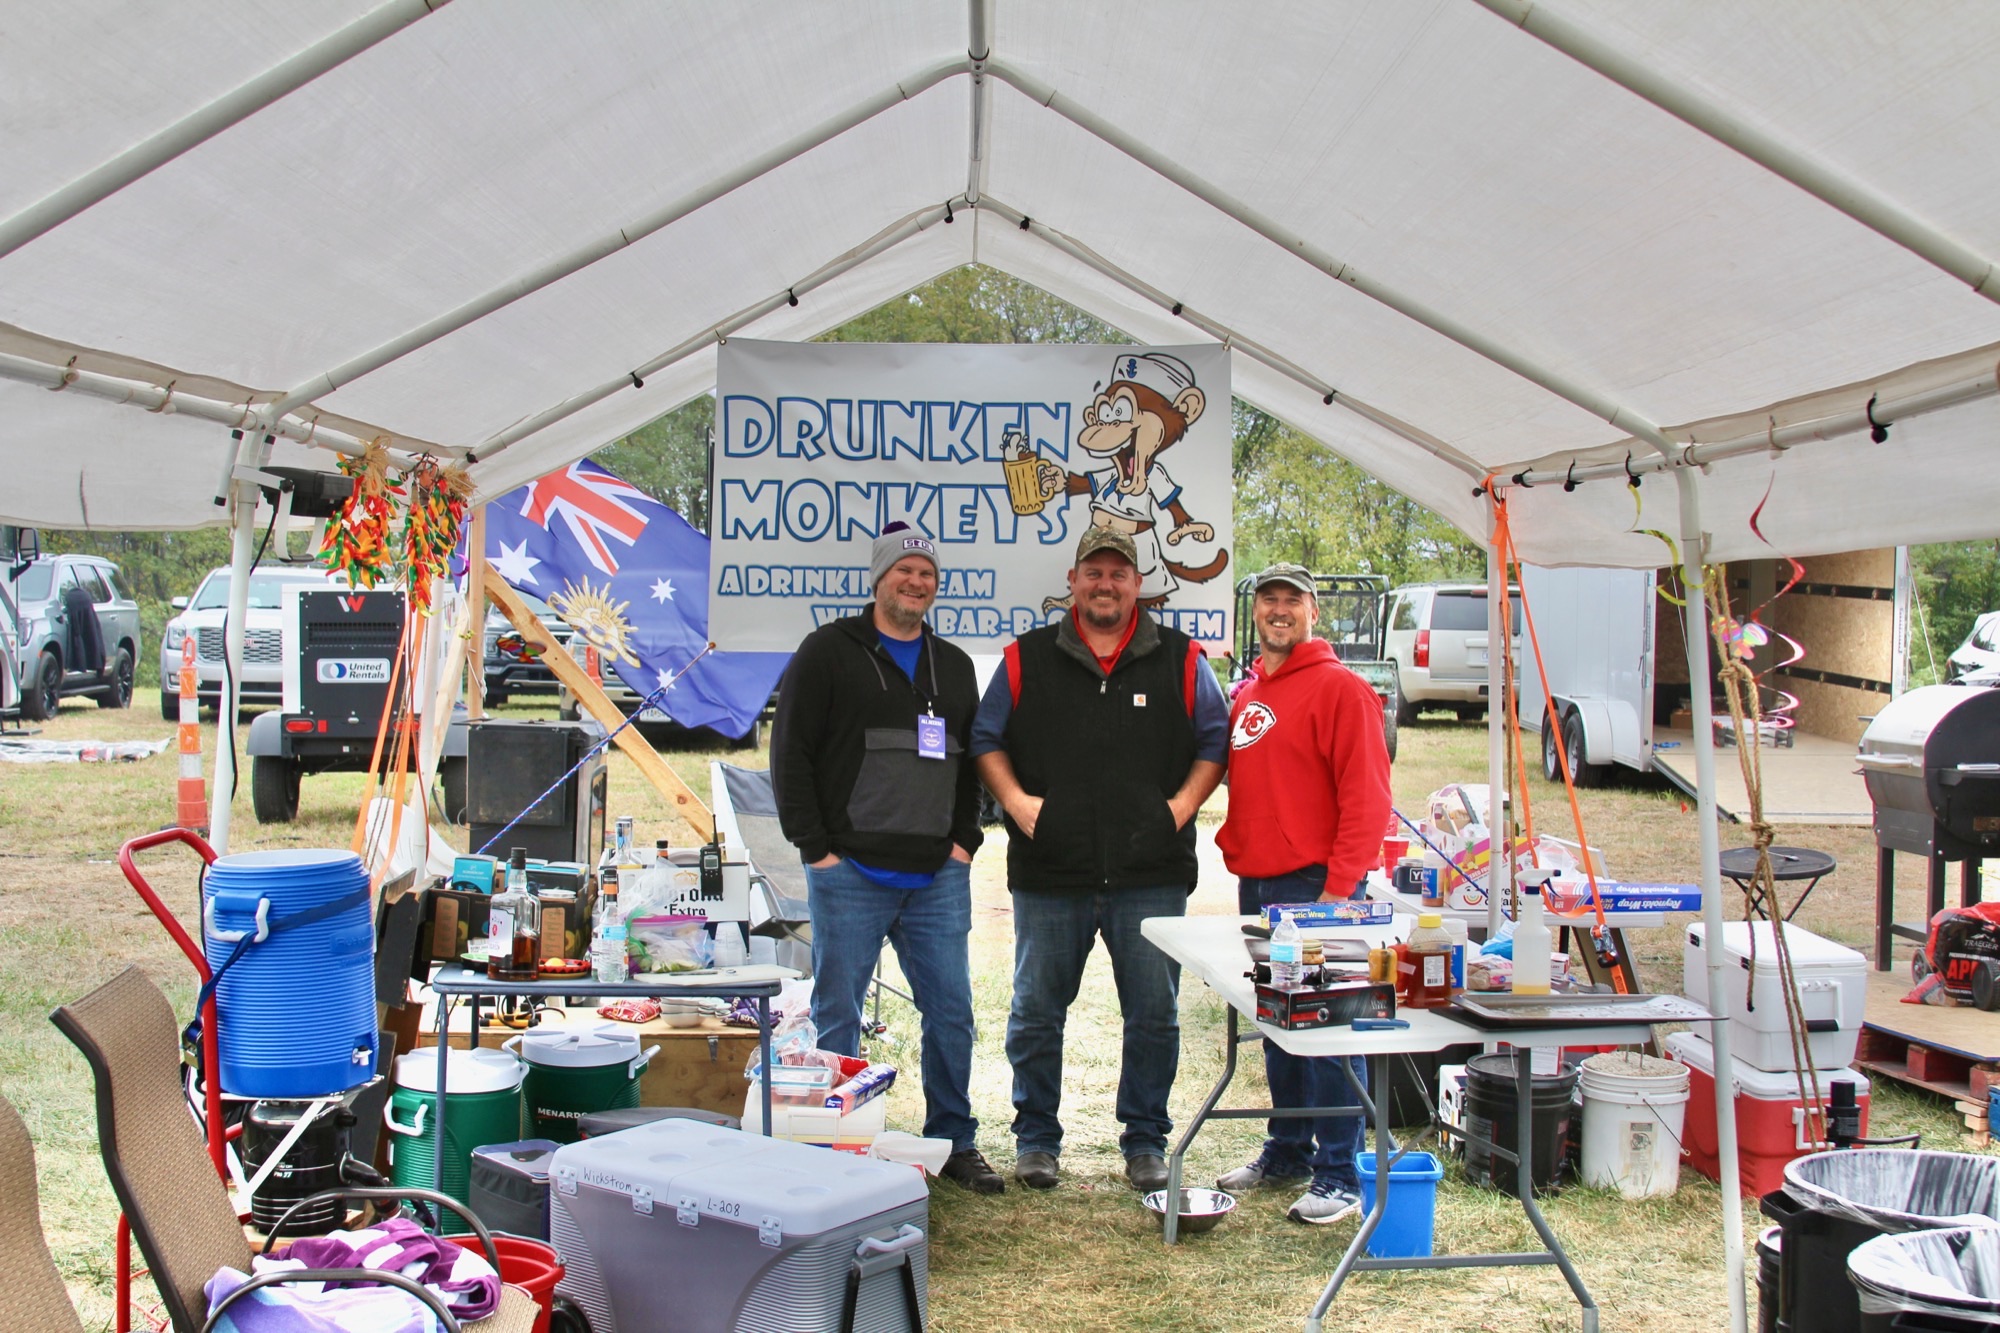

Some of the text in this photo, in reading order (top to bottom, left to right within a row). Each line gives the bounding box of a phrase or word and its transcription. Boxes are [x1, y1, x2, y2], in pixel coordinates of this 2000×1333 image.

[723, 395, 1071, 464] DRUNKEN
[717, 565, 996, 599] A DRINKIN EAM
[349, 662, 383, 672] United
[349, 670, 386, 680] Rentals
[1617, 898, 1642, 910] Wrap
[1641, 898, 1682, 909] Reynolds
[669, 903, 706, 917] Extra
[1307, 911, 1327, 919] Wrap
[1964, 939, 1999, 951] TRAEGER
[583, 1167, 633, 1192] Wickstrom
[706, 1197, 741, 1217] L-208
